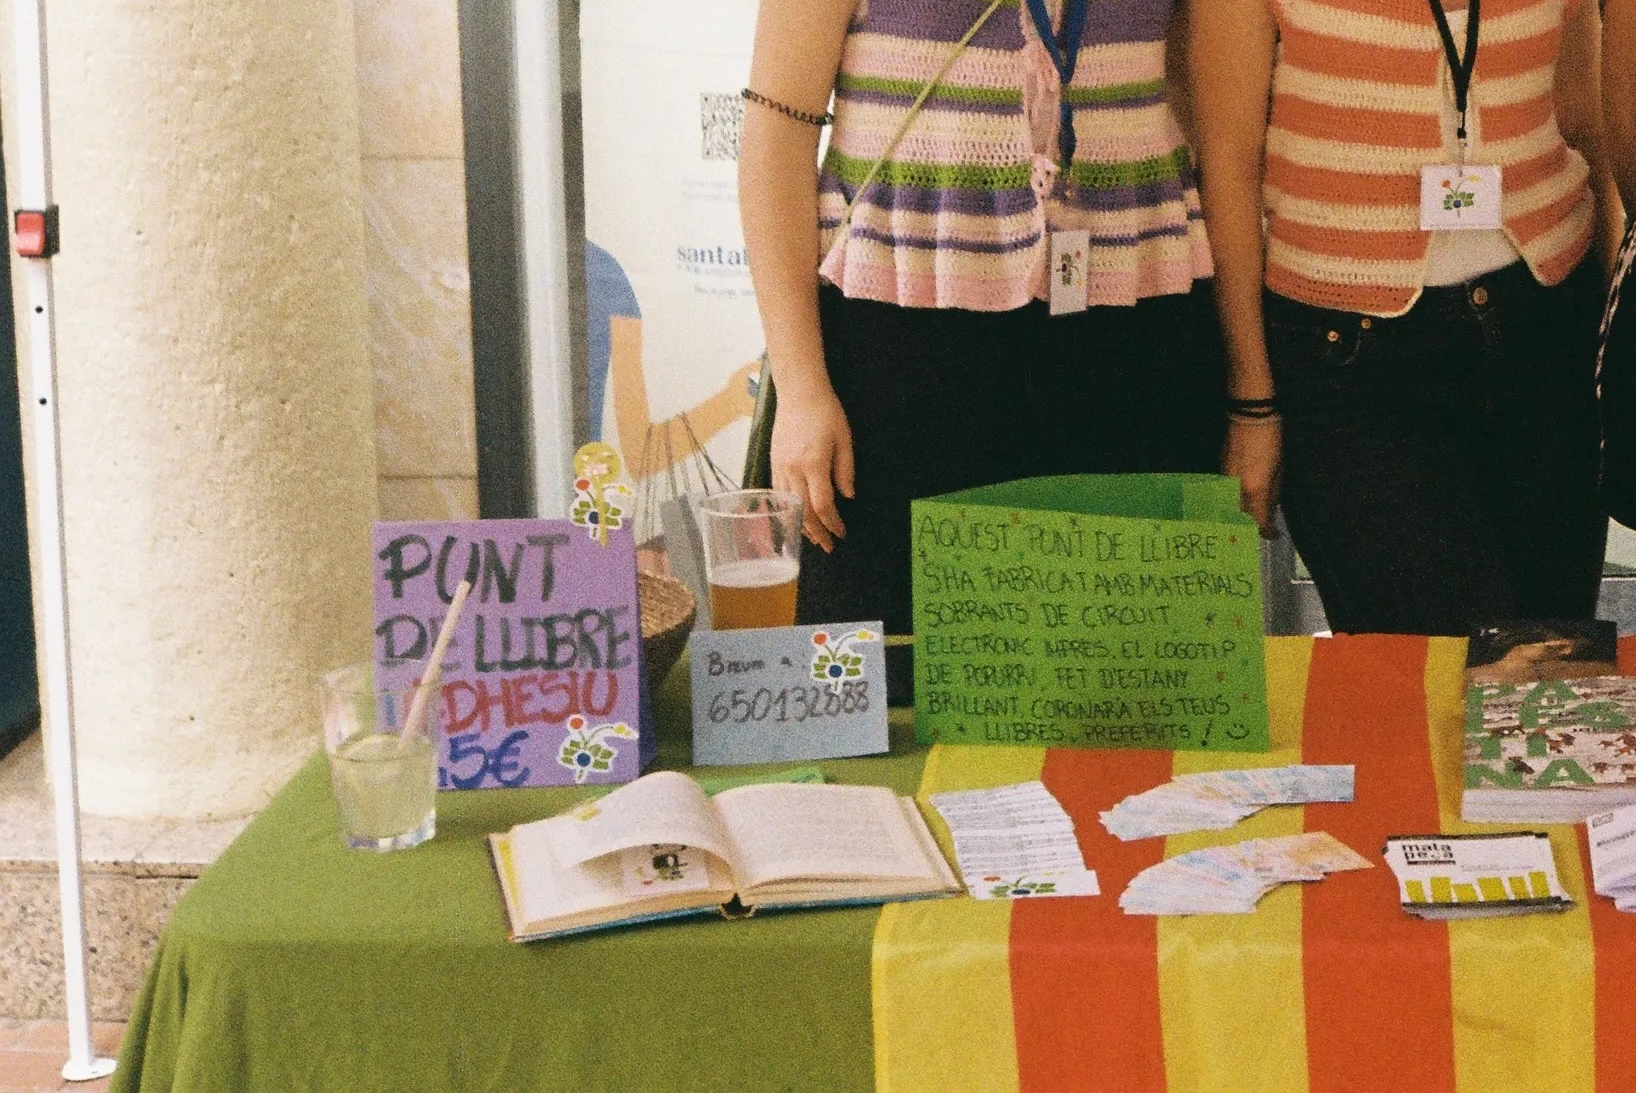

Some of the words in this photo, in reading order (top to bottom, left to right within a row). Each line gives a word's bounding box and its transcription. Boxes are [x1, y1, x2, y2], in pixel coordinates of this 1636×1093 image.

[918, 515, 1010, 553] AQUEST
[1023, 524, 1084, 558] PUNT
[1095, 530, 1124, 562] DE
[1140, 532, 1218, 563] LLIBRE
[377, 533, 570, 605] PUNT
[474, 605, 632, 673] LLIBRE
[923, 599, 1030, 628] SOBRANTS
[1040, 602, 1069, 628] DE
